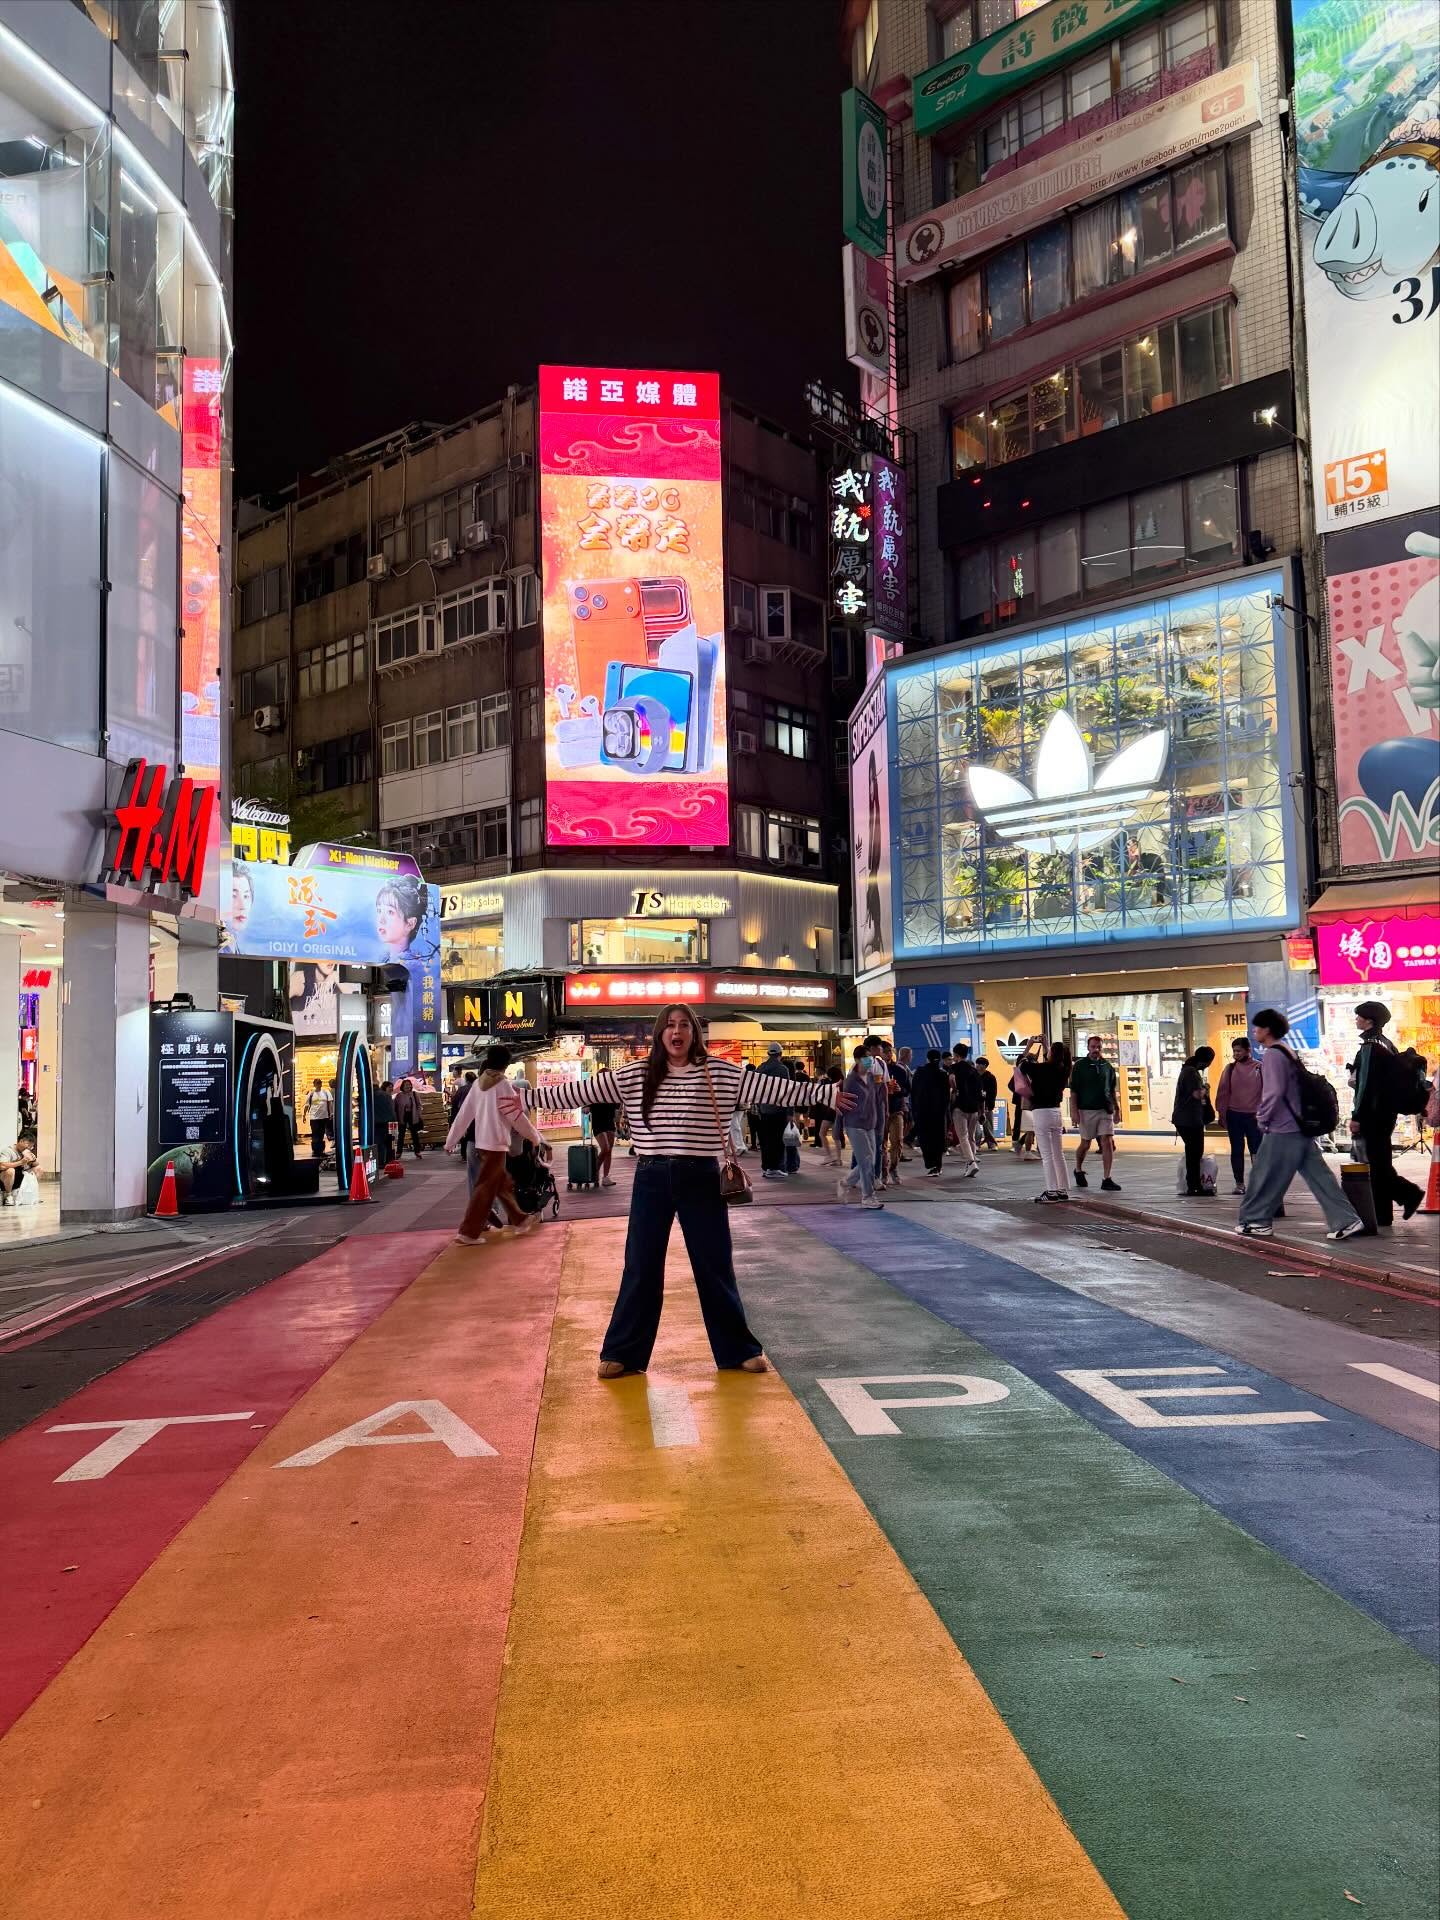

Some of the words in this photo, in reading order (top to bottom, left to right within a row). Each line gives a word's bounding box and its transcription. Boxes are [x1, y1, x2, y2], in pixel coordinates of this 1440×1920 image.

[935, 84, 968, 112] SPA
[1209, 94, 1238, 116] 6F
[562, 377, 698, 406] 諾亞媒體
[1334, 494, 1381, 516] 輔15級
[832, 468, 871, 615] 我就厲害
[877, 466, 903, 601] 我就厲害
[852, 678, 886, 760] SUPERSTAR
[114, 757, 215, 897] H&M
[669, 899, 692, 910] Hair
[696, 899, 728, 910] Salon
[1402, 959, 1437, 967] TAIWAN
[1224, 1013, 1247, 1026] THE
[160, 1043, 227, 1055] 極限返航
